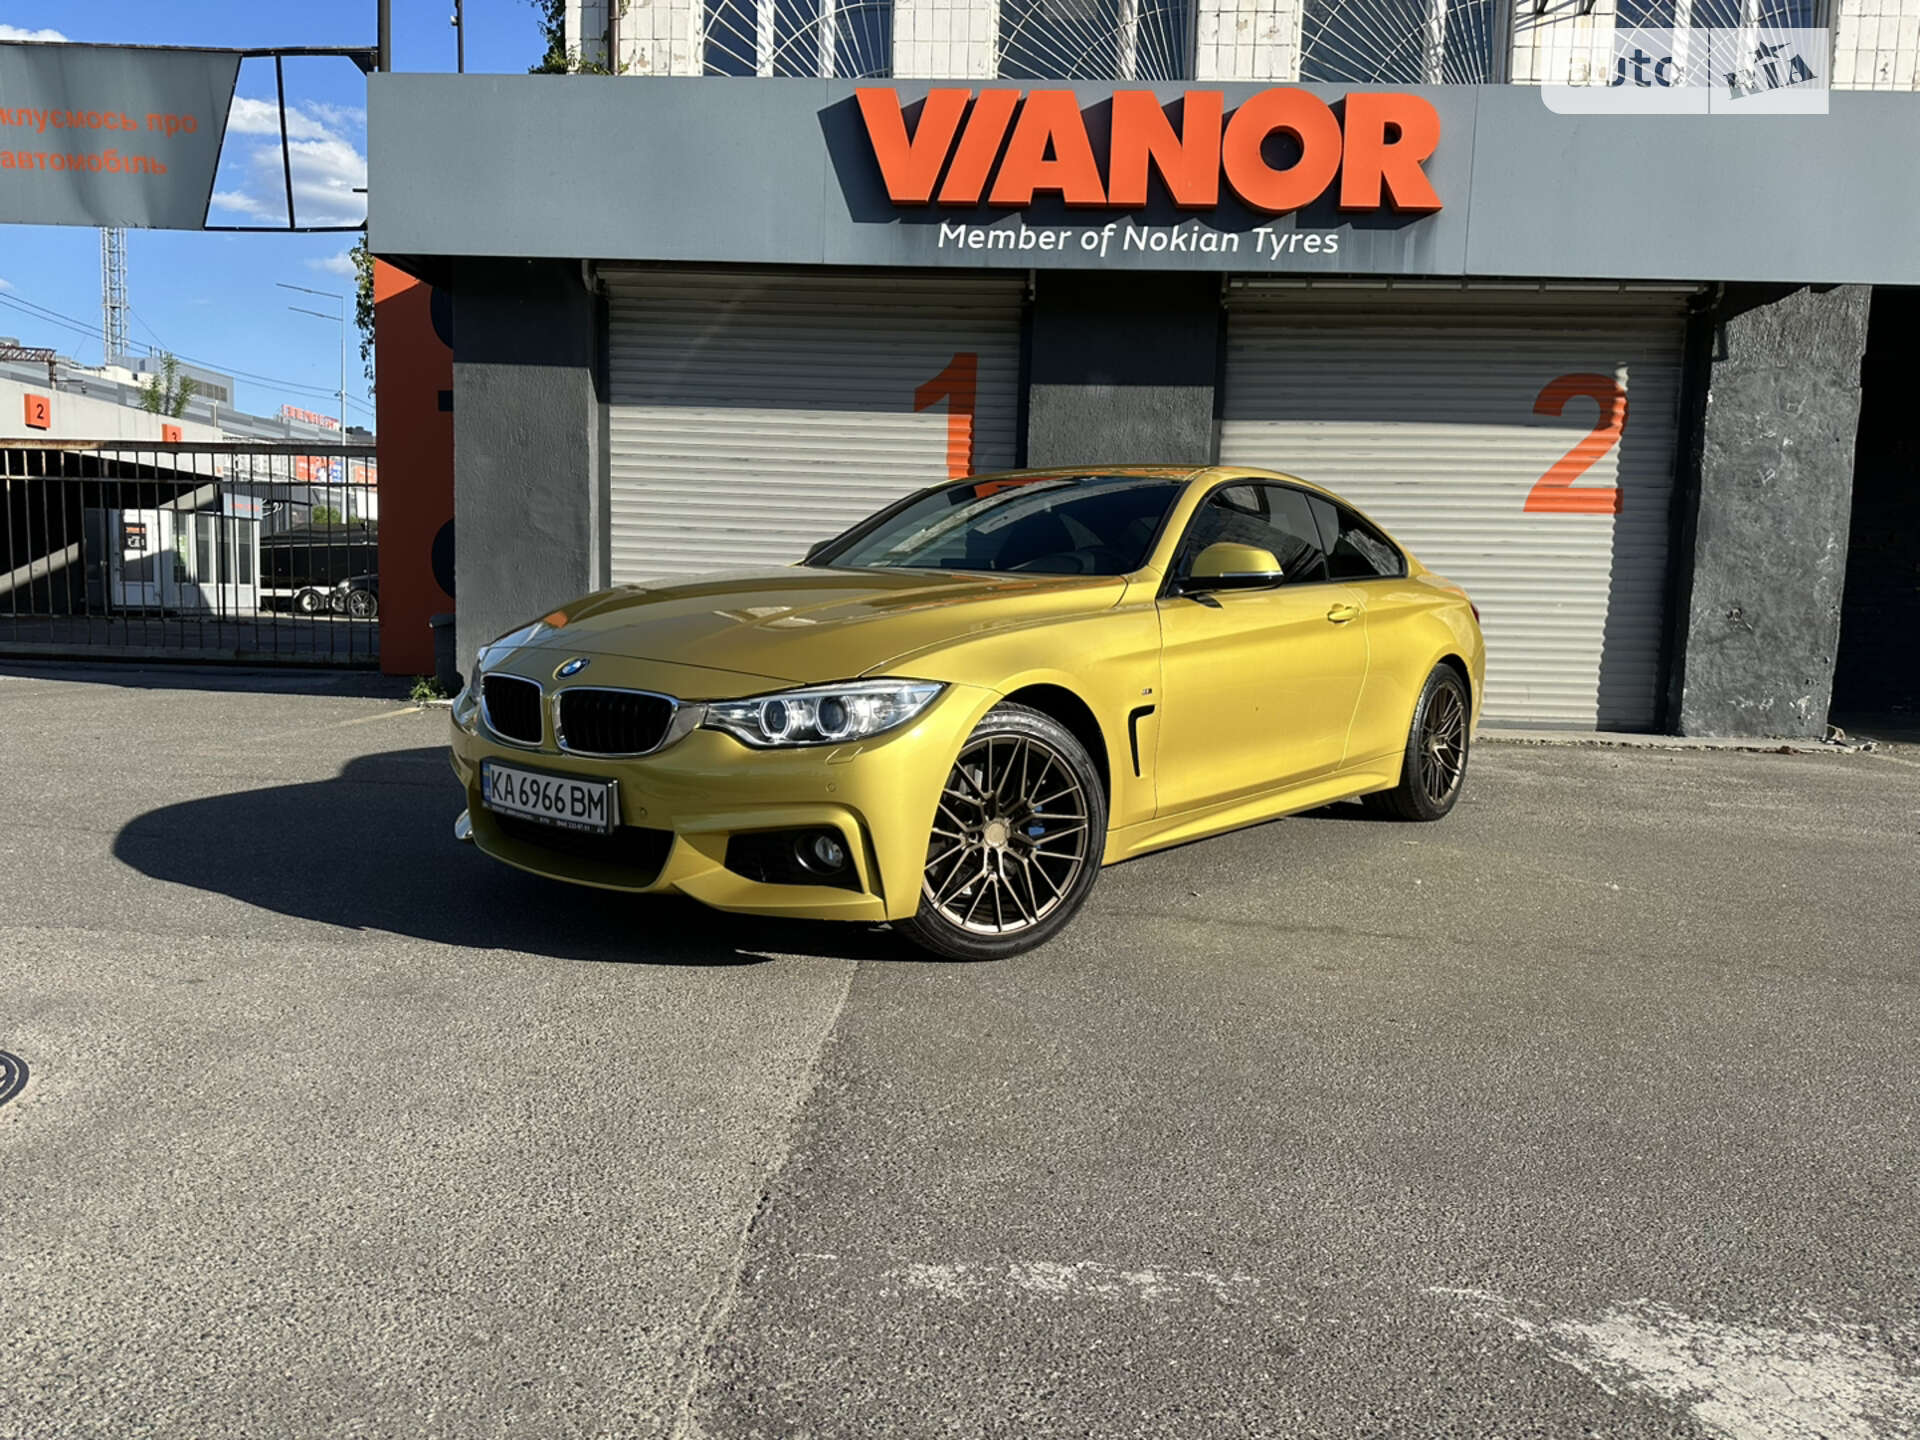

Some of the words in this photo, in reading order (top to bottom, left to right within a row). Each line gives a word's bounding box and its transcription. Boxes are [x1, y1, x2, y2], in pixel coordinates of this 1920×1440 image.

[147, 113, 198, 137] про
[856, 87, 1443, 213] VIANOR
[937, 223, 1072, 250] Member
[1080, 223, 1116, 257] of
[1123, 225, 1239, 252] Nokian
[1252, 227, 1339, 260] Tyres
[36, 403, 45, 420] 2
[913, 352, 978, 479] 1
[1523, 373, 1629, 514] 2
